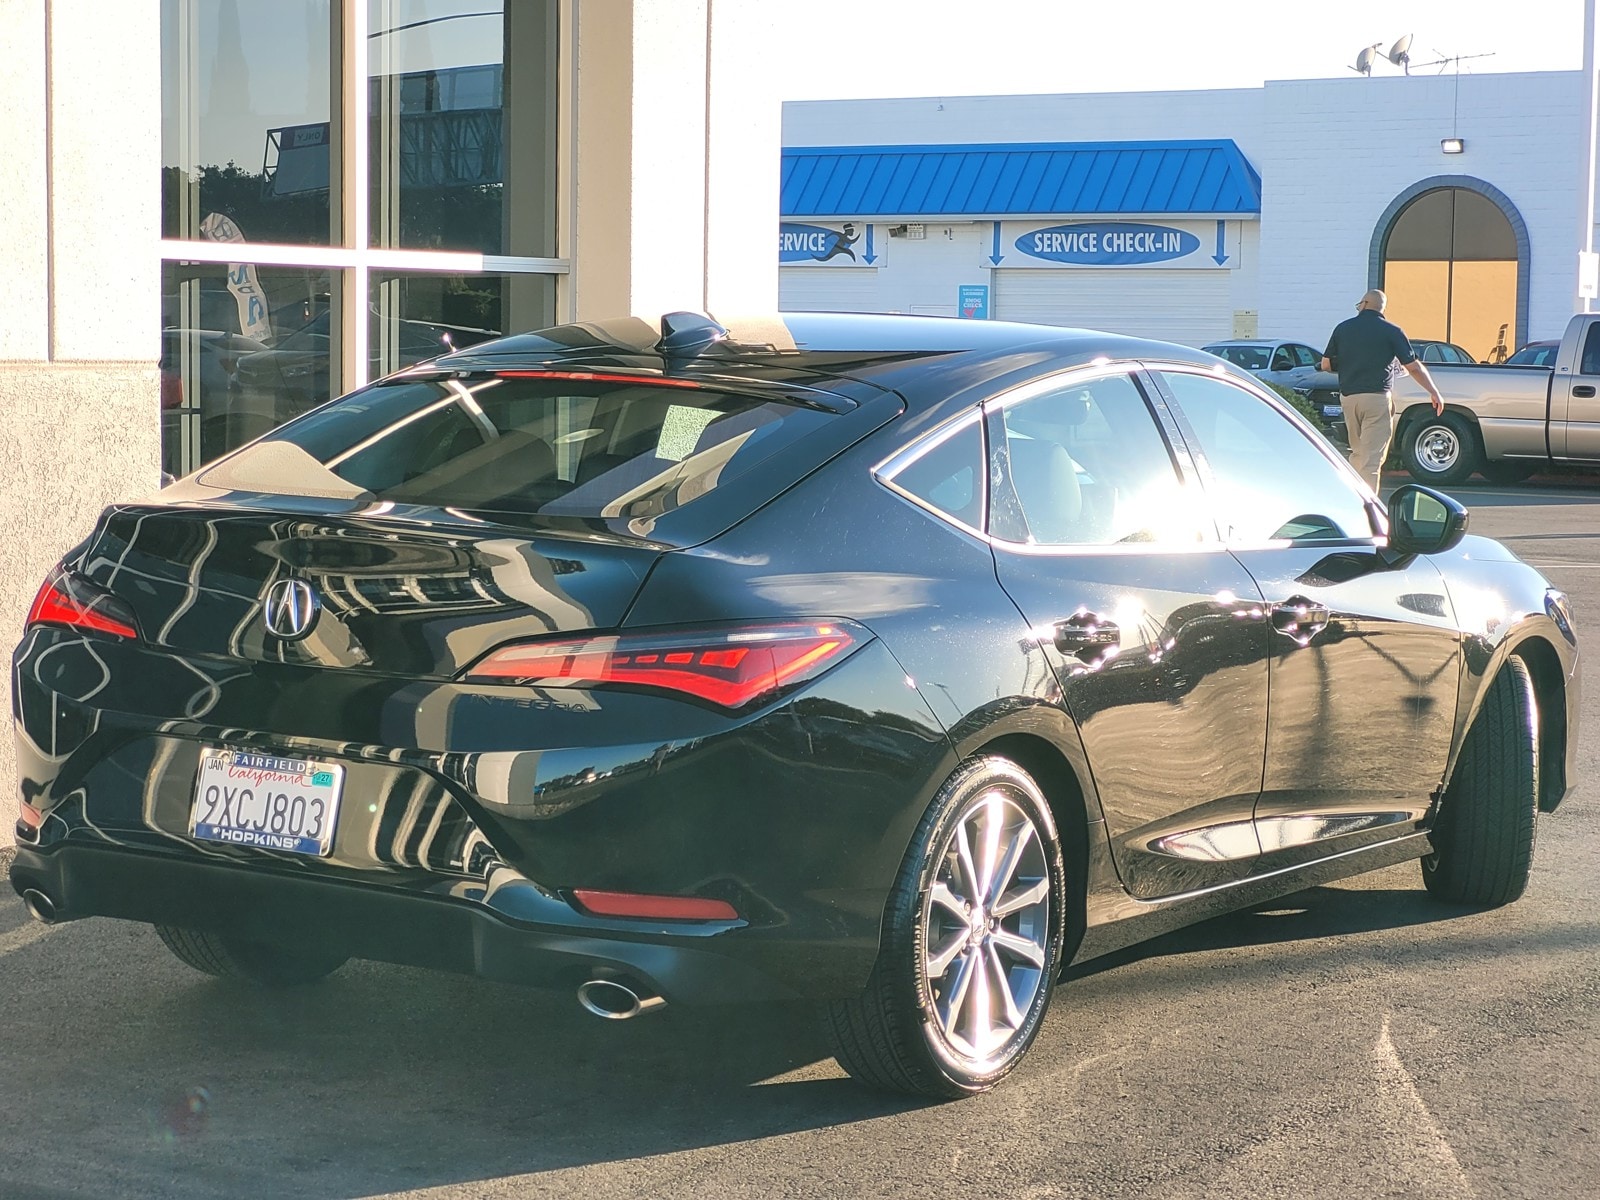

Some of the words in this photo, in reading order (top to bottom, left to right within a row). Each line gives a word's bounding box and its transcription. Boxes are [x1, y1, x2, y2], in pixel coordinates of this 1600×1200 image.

[1034, 232, 1098, 253] SERVICE
[1102, 232, 1181, 253] CHECK-IN
[208, 758, 224, 772] JAN
[234, 753, 306, 773] FAIRFIELD
[228, 765, 312, 788] California
[320, 774, 330, 783] 27
[201, 784, 326, 839] 9XCJ803
[220, 827, 294, 849] HOPKINS
